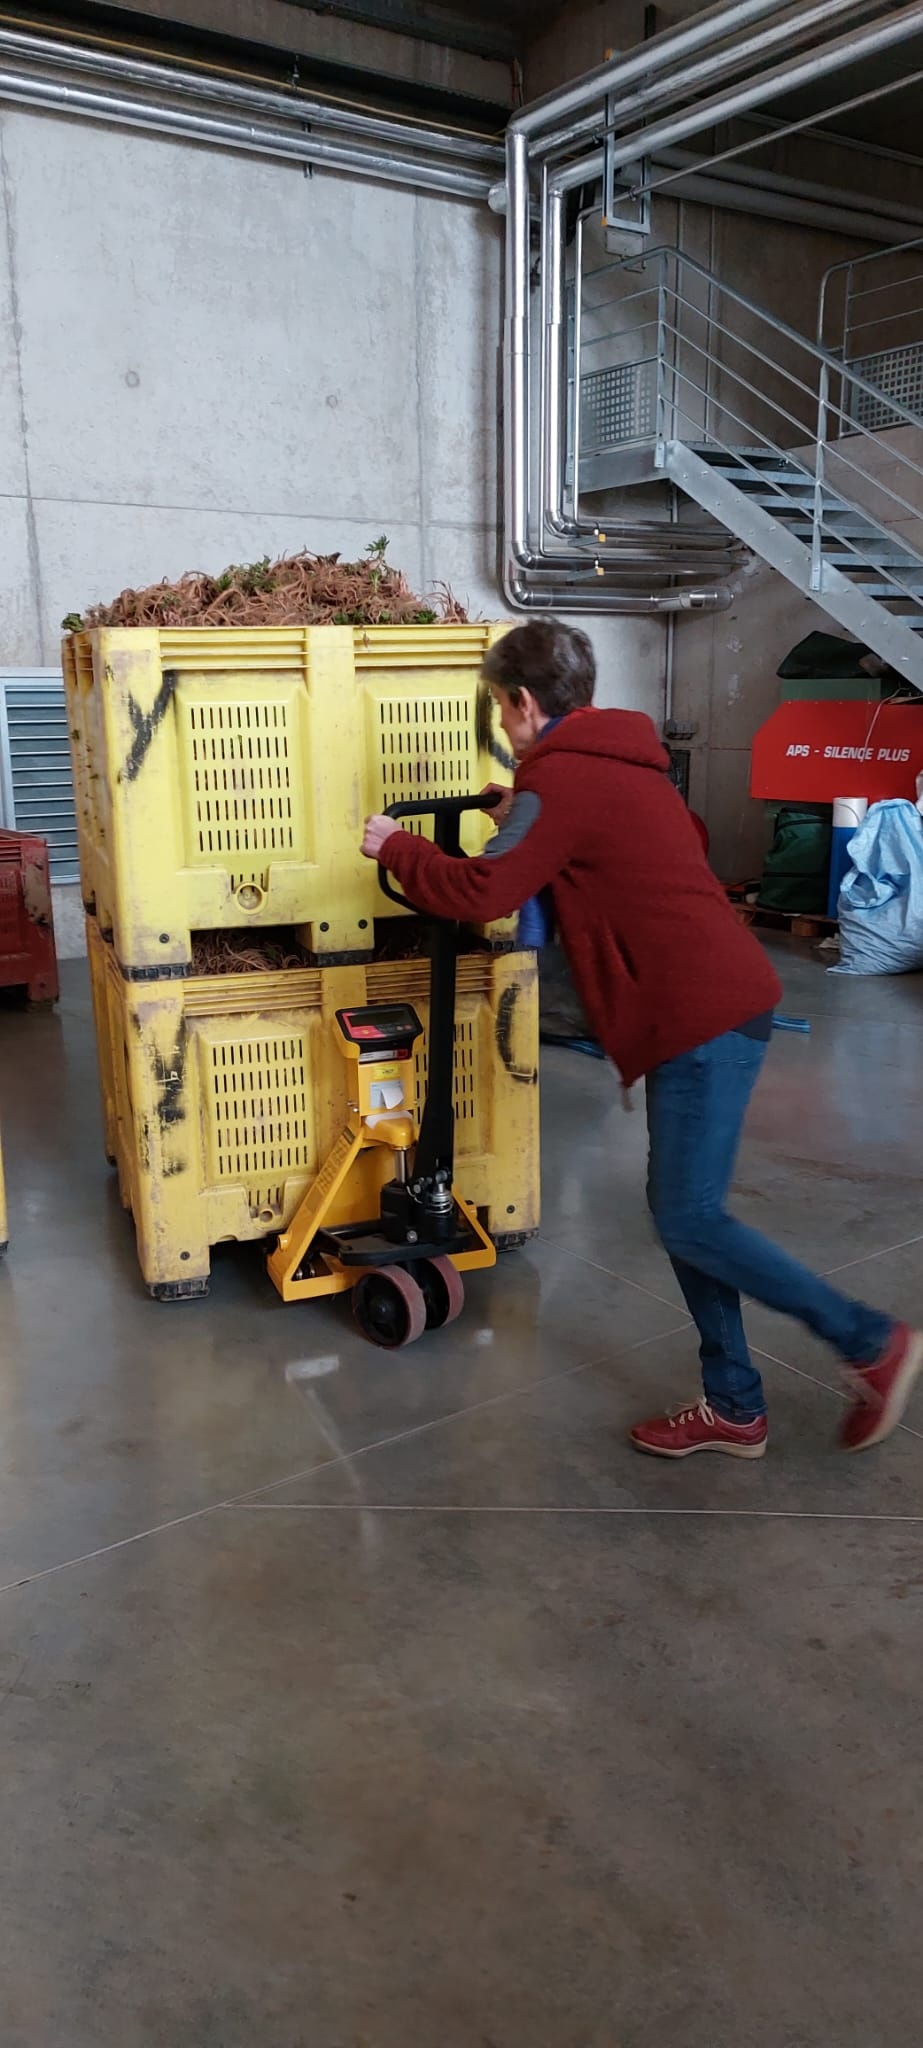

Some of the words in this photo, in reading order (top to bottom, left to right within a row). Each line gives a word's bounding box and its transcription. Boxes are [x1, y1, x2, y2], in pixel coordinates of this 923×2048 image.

[786, 744, 810, 757] APS
[823, 745, 874, 760] SILENCE
[877, 748, 911, 762] PLUS
